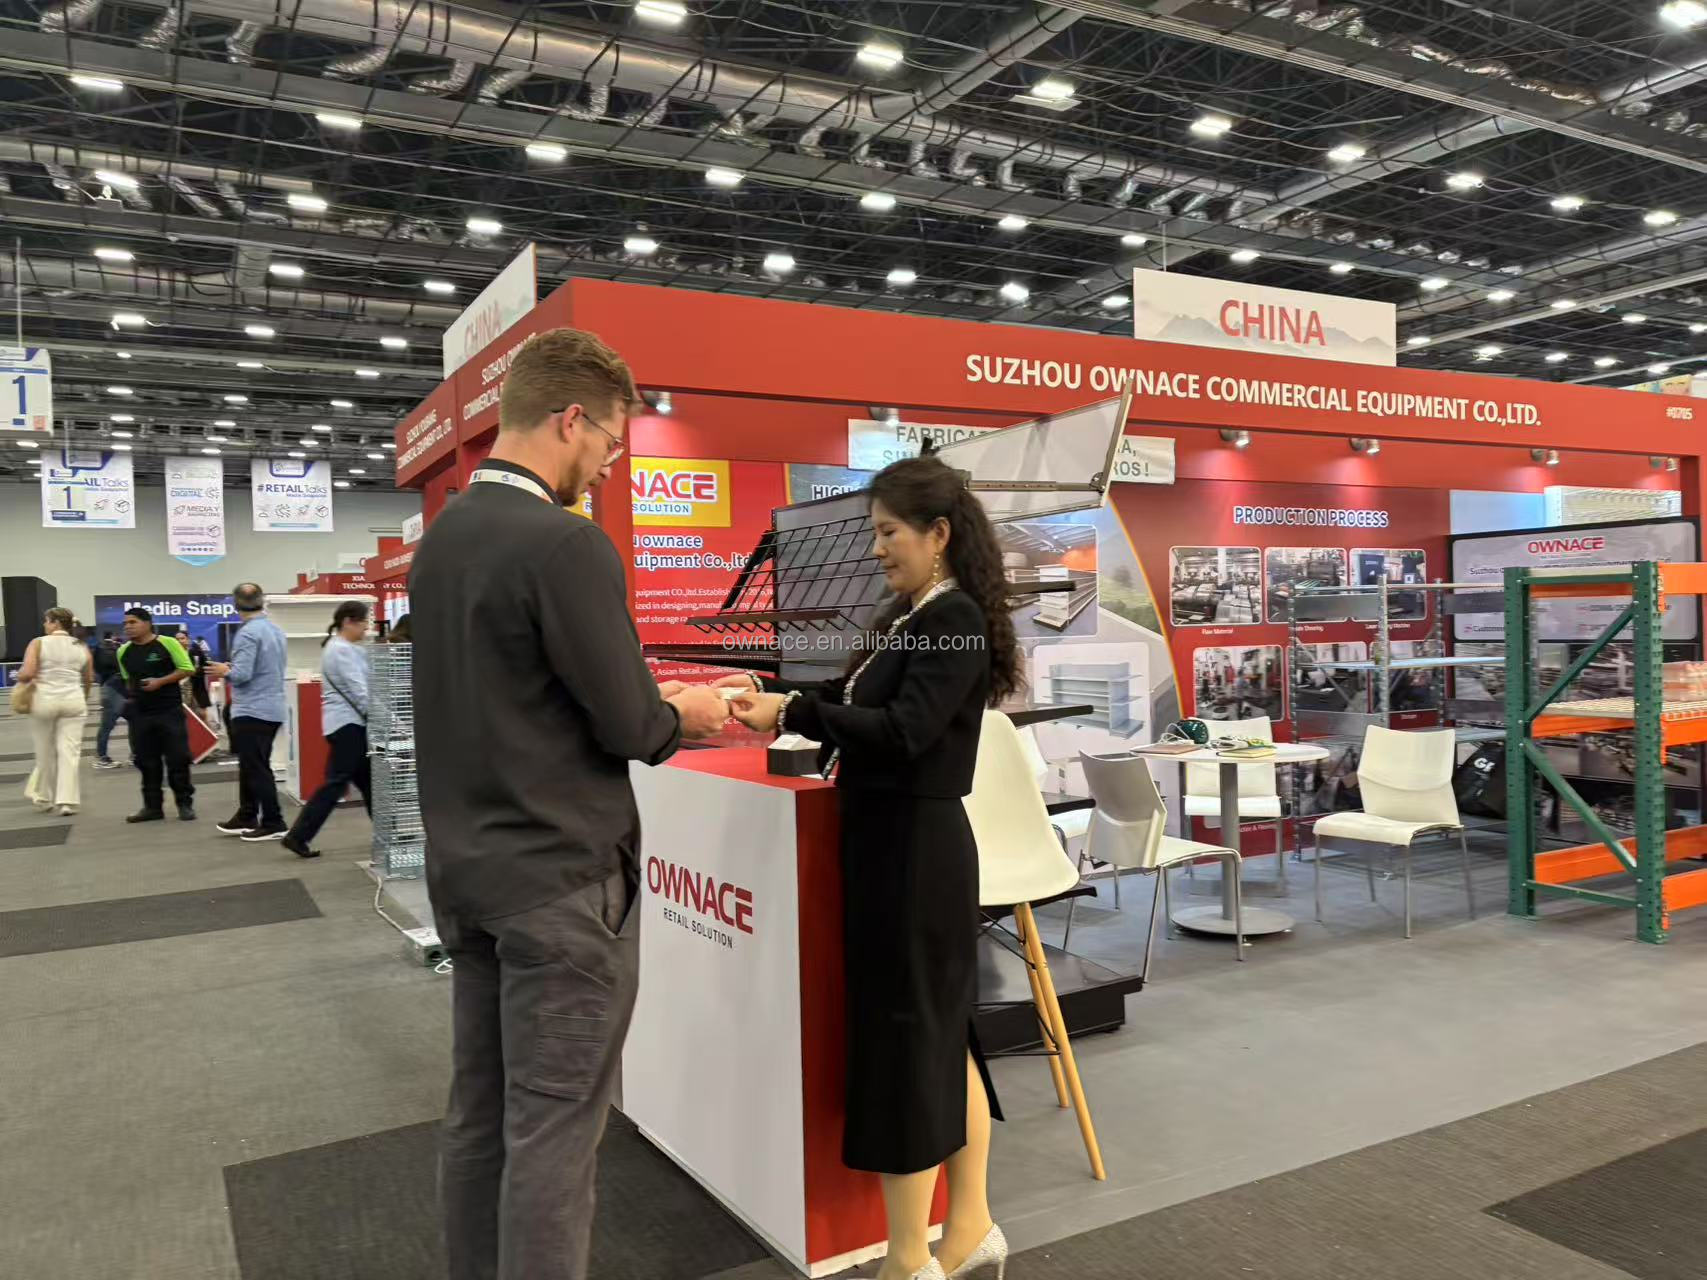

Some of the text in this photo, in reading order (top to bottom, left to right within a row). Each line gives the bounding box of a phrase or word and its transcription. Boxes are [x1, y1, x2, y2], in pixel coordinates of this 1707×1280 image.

[464, 299, 501, 356] CHINA
[1220, 299, 1327, 346] CHINA
[12, 375, 27, 415] 1
[966, 355, 1542, 426] SUZHOU OWNACE COMMERCIAL EQUIPMENT CO.,LTD.
[896, 426, 991, 444] FABRICA
[63, 486, 72, 510] 1
[632, 504, 690, 513] SOLUTION
[1234, 506, 1389, 527] PRODUCTION PROCESS
[642, 536, 703, 548] ownace
[1528, 537, 1604, 554] OWNACE
[187, 600, 238, 618] Snap
[647, 855, 753, 935] OWNACE
[664, 907, 734, 949] RETAIL SOLUTION
